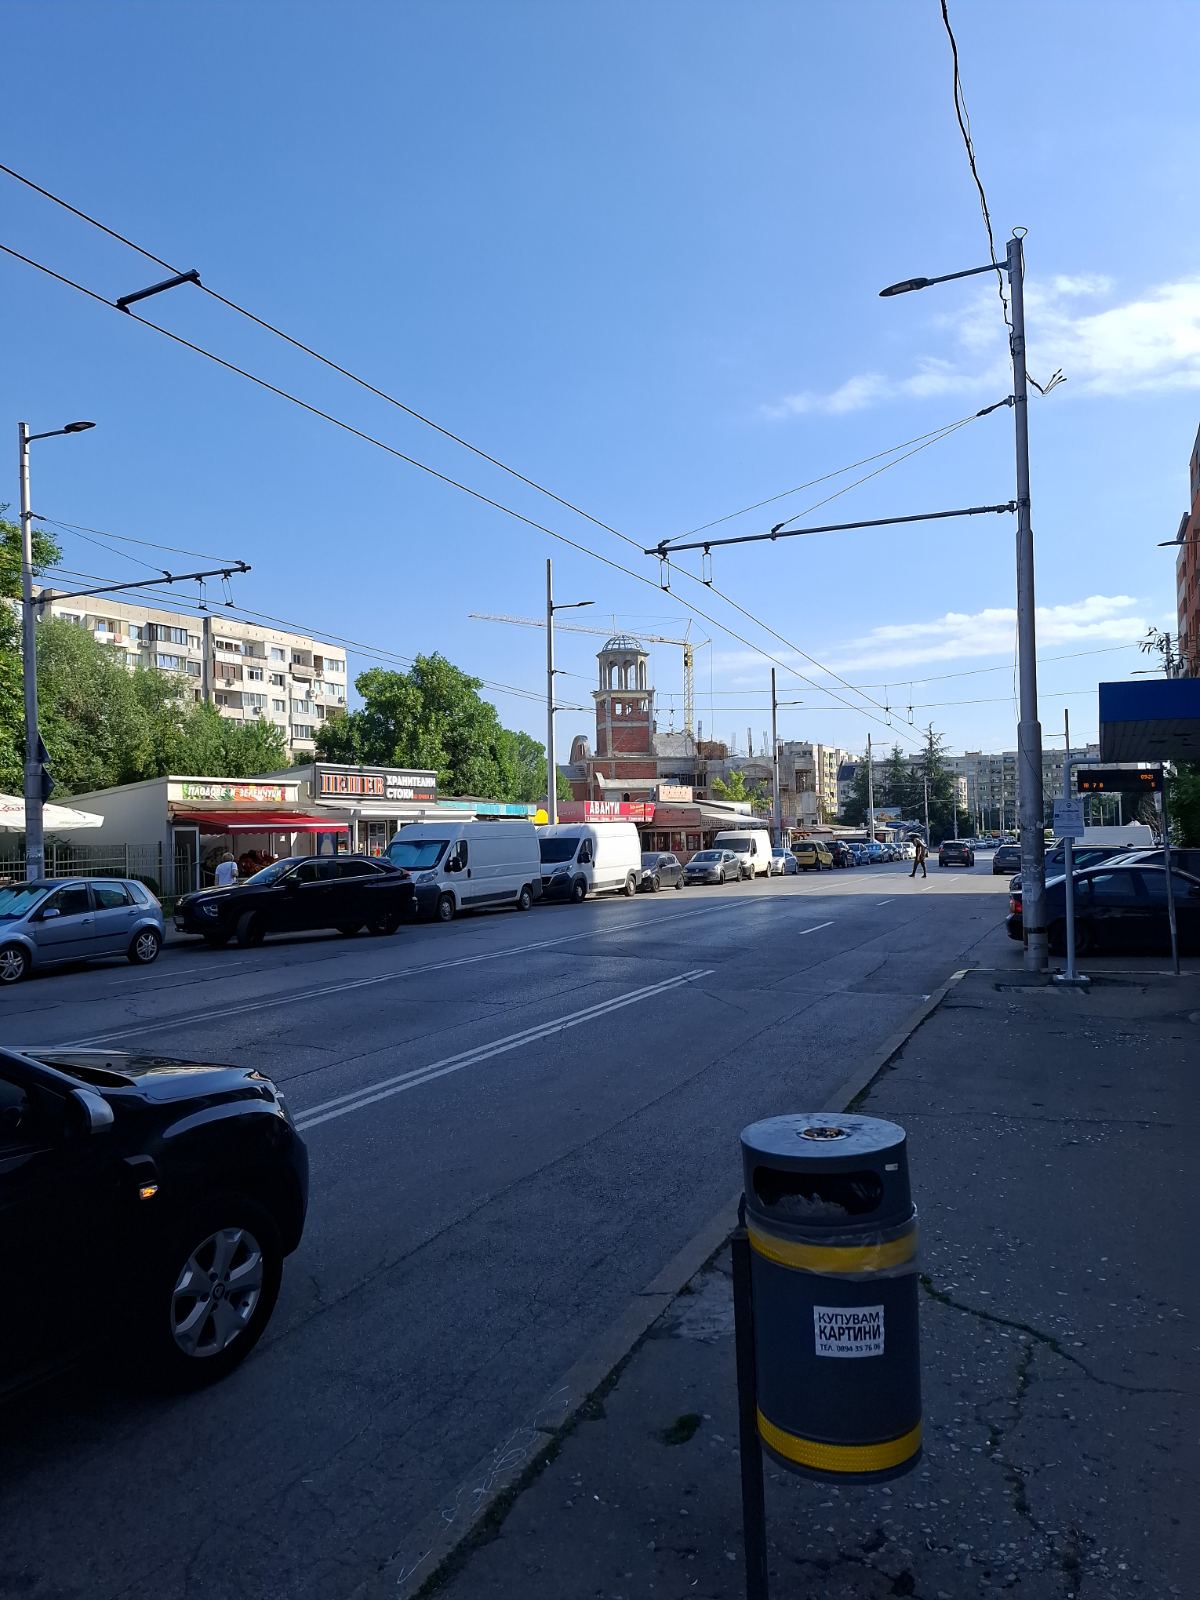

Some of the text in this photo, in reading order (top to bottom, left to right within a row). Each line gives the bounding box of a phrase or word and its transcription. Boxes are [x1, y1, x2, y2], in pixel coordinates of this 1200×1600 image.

[386, 775, 436, 787] ХРАНИТЕЛНИ
[187, 785, 226, 797] ПЛОДОВЕ
[386, 788, 413, 799] СТОКИ
[589, 801, 620, 815] АВАНТИ
[818, 1312, 880, 1325] КУПУВАМ
[818, 1324, 881, 1341] КАРТИНИ
